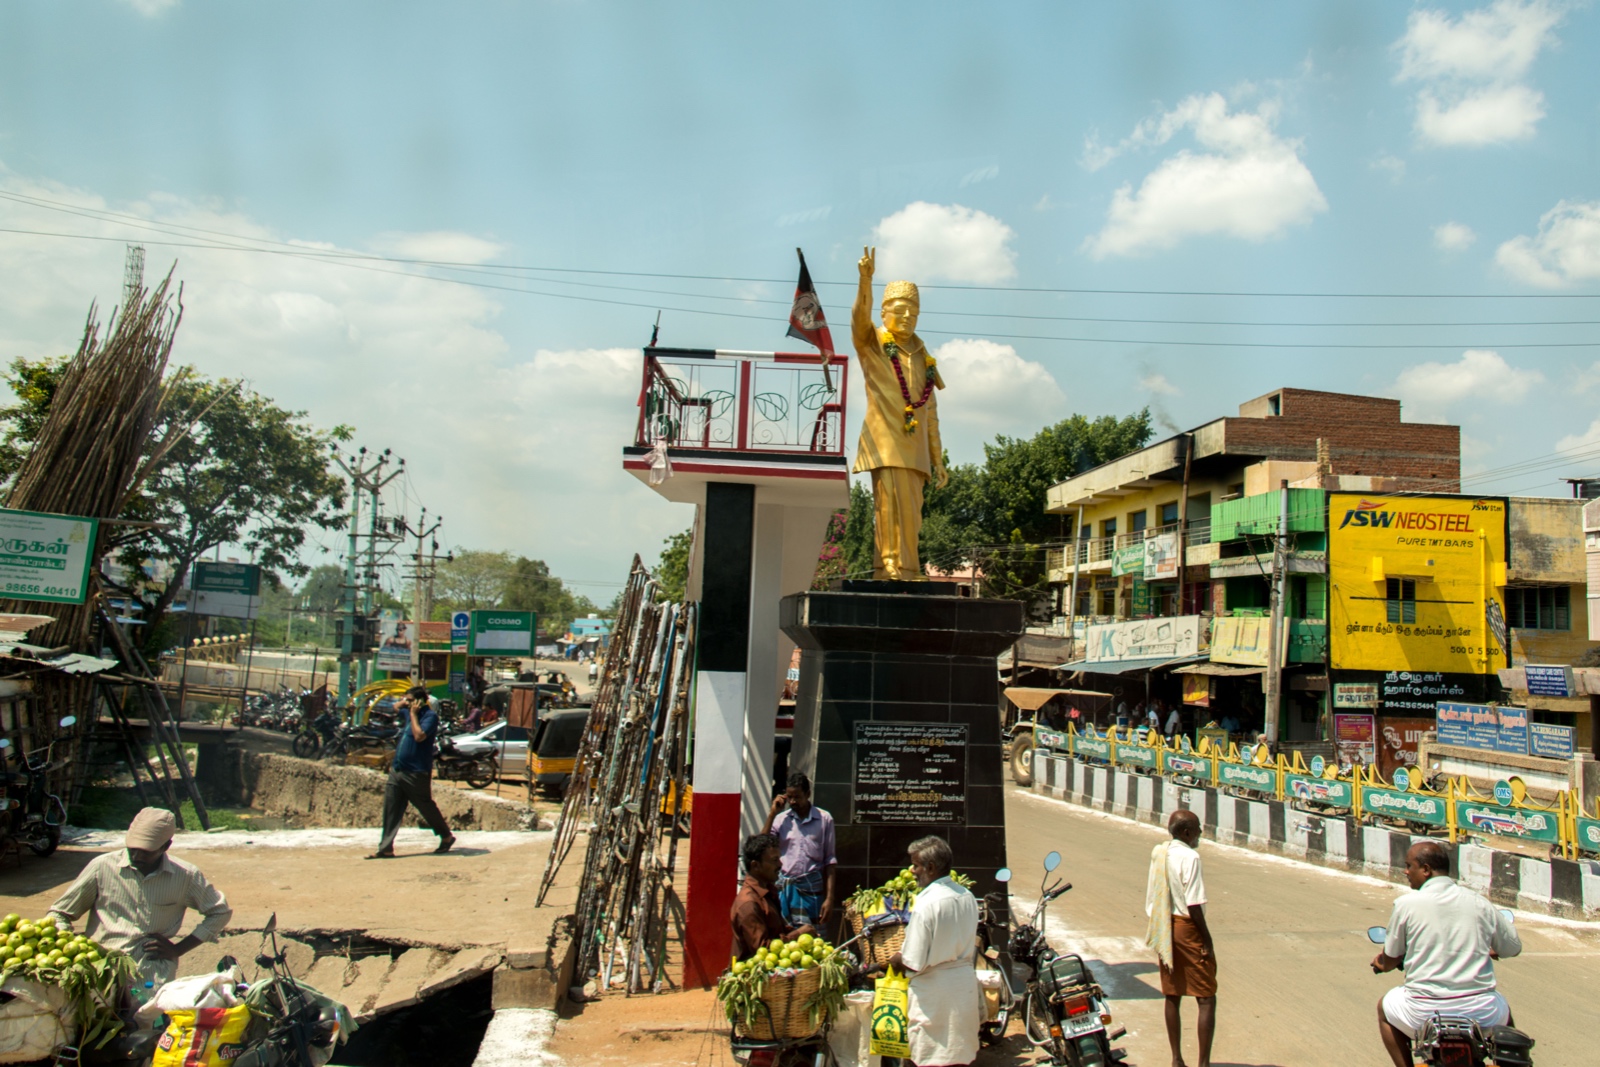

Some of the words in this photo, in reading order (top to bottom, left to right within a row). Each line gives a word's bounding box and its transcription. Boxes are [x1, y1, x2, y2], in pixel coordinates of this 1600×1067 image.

[1338, 510, 1396, 530] JSW
[1395, 512, 1474, 533] NEOSTEEL
[1397, 536, 1426, 547] PURE
[1428, 538, 1444, 547] TMT
[1444, 539, 1474, 548] BARS
[5, 583, 40, 593] 98656
[43, 586, 77, 596] 40410
[487, 618, 522, 626] COSMO
[1396, 774, 1409, 784] OMS
[1496, 787, 1511, 798] OMS
